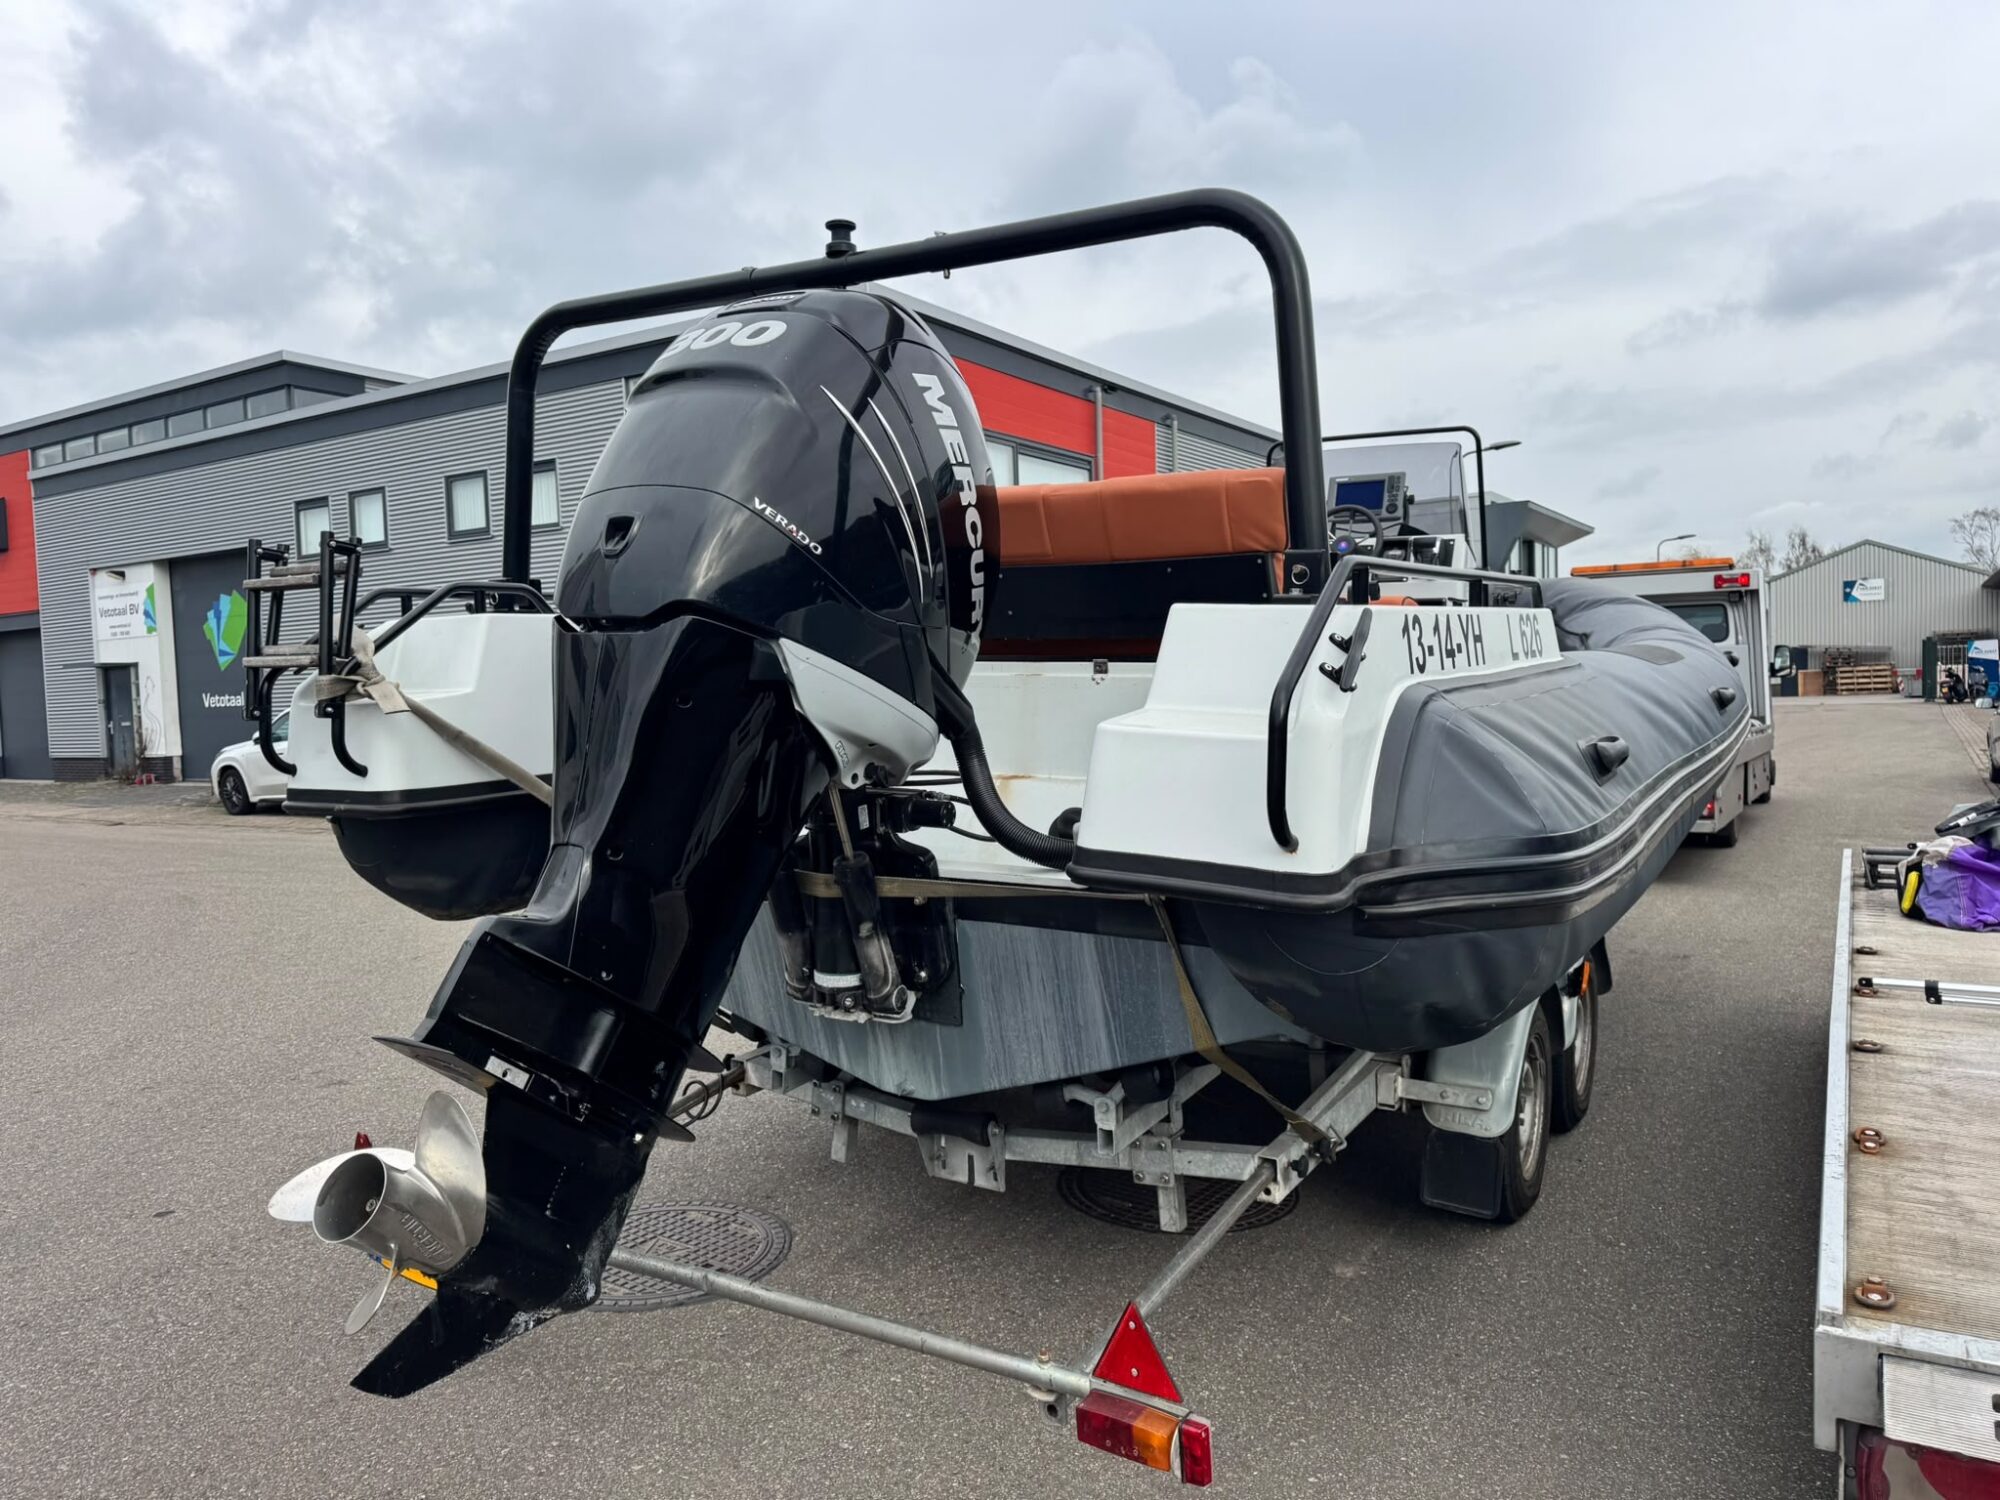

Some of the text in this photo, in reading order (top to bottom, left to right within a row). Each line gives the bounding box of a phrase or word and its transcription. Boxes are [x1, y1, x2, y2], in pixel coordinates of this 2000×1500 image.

[754, 496, 822, 555] VERADO
[1401, 613, 1486, 675] 13-14-YH
[1506, 612, 1543, 661] L 626
[202, 691, 245, 708] Vetotaal
